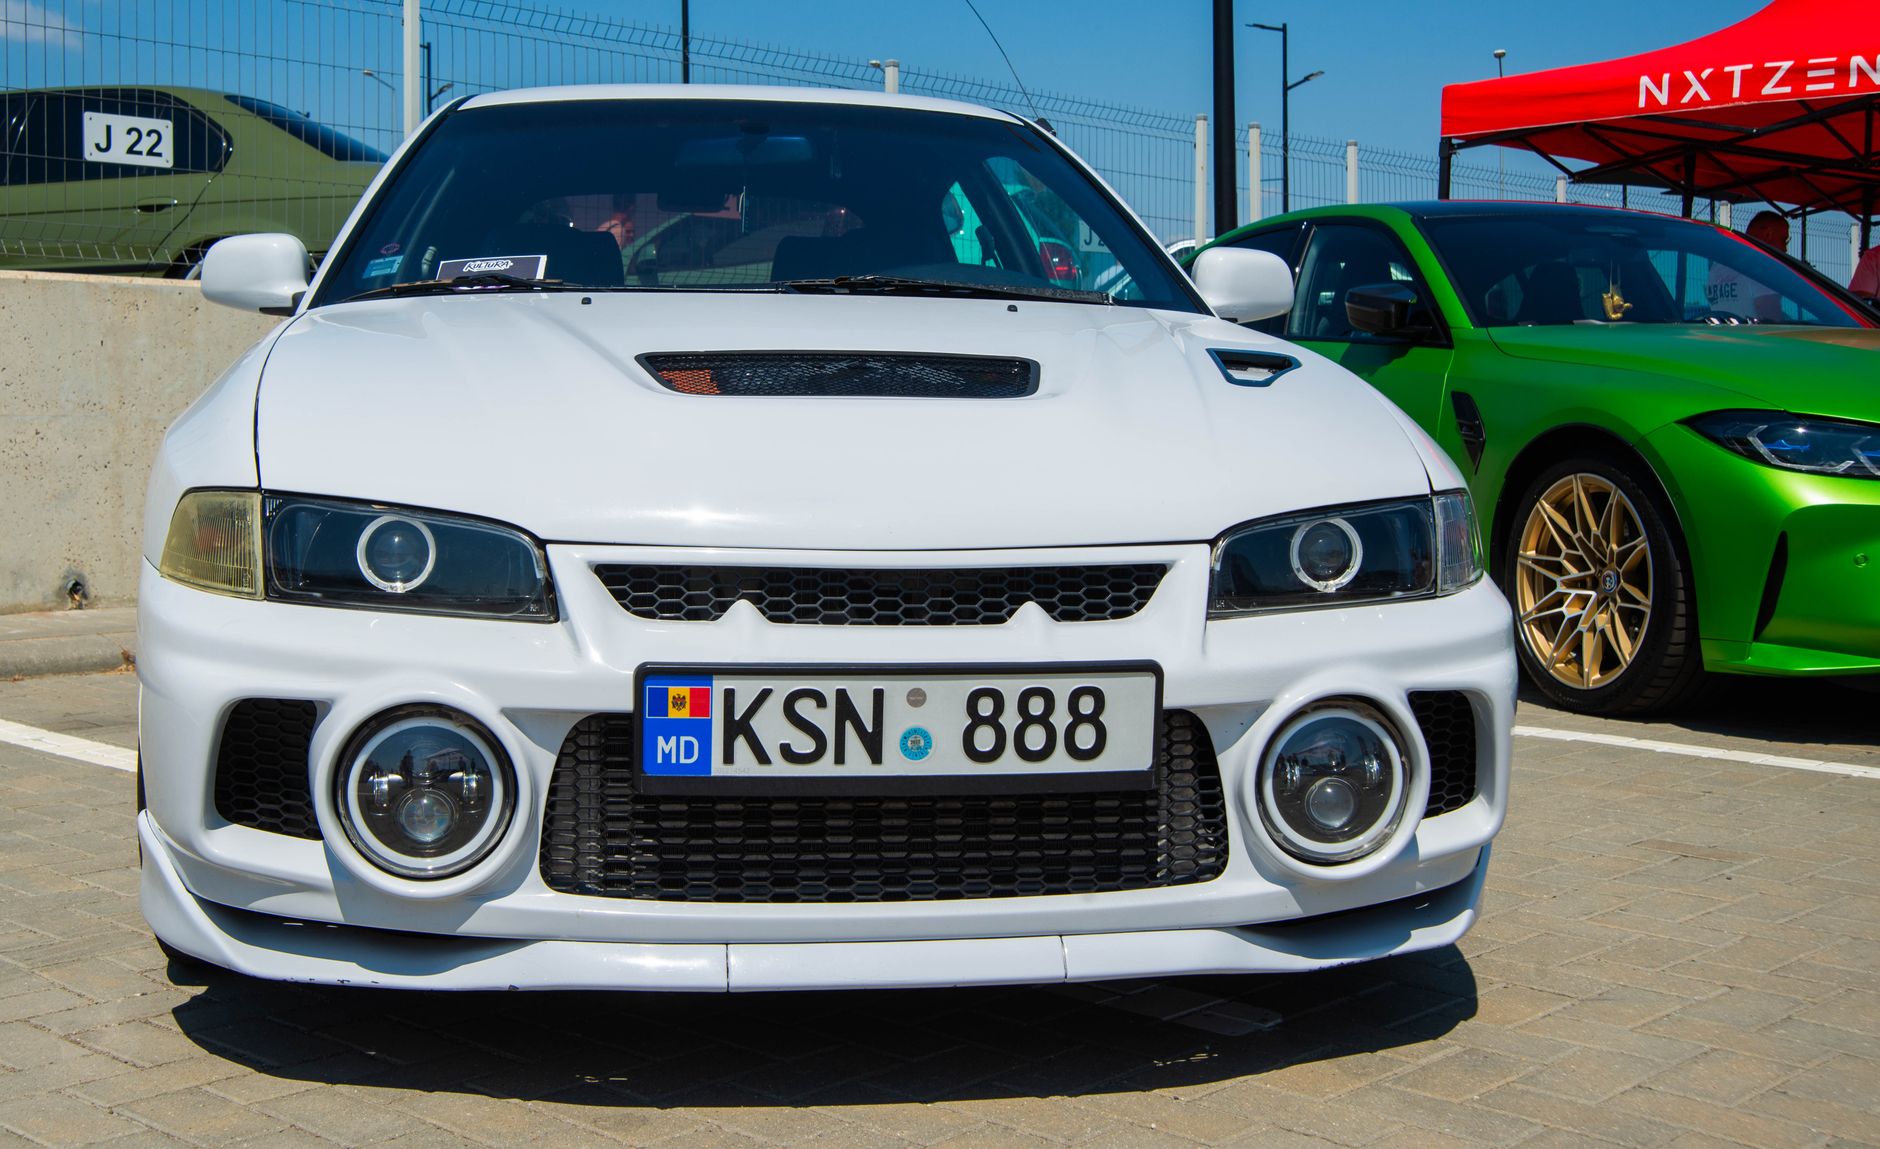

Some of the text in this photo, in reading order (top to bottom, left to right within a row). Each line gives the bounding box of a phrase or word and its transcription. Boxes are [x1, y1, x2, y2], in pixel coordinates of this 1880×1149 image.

[1638, 54, 1880, 108] NXTZEN
[94, 124, 163, 157] J 22
[722, 686, 1108, 765] KSN 888
[656, 736, 699, 764] MD
